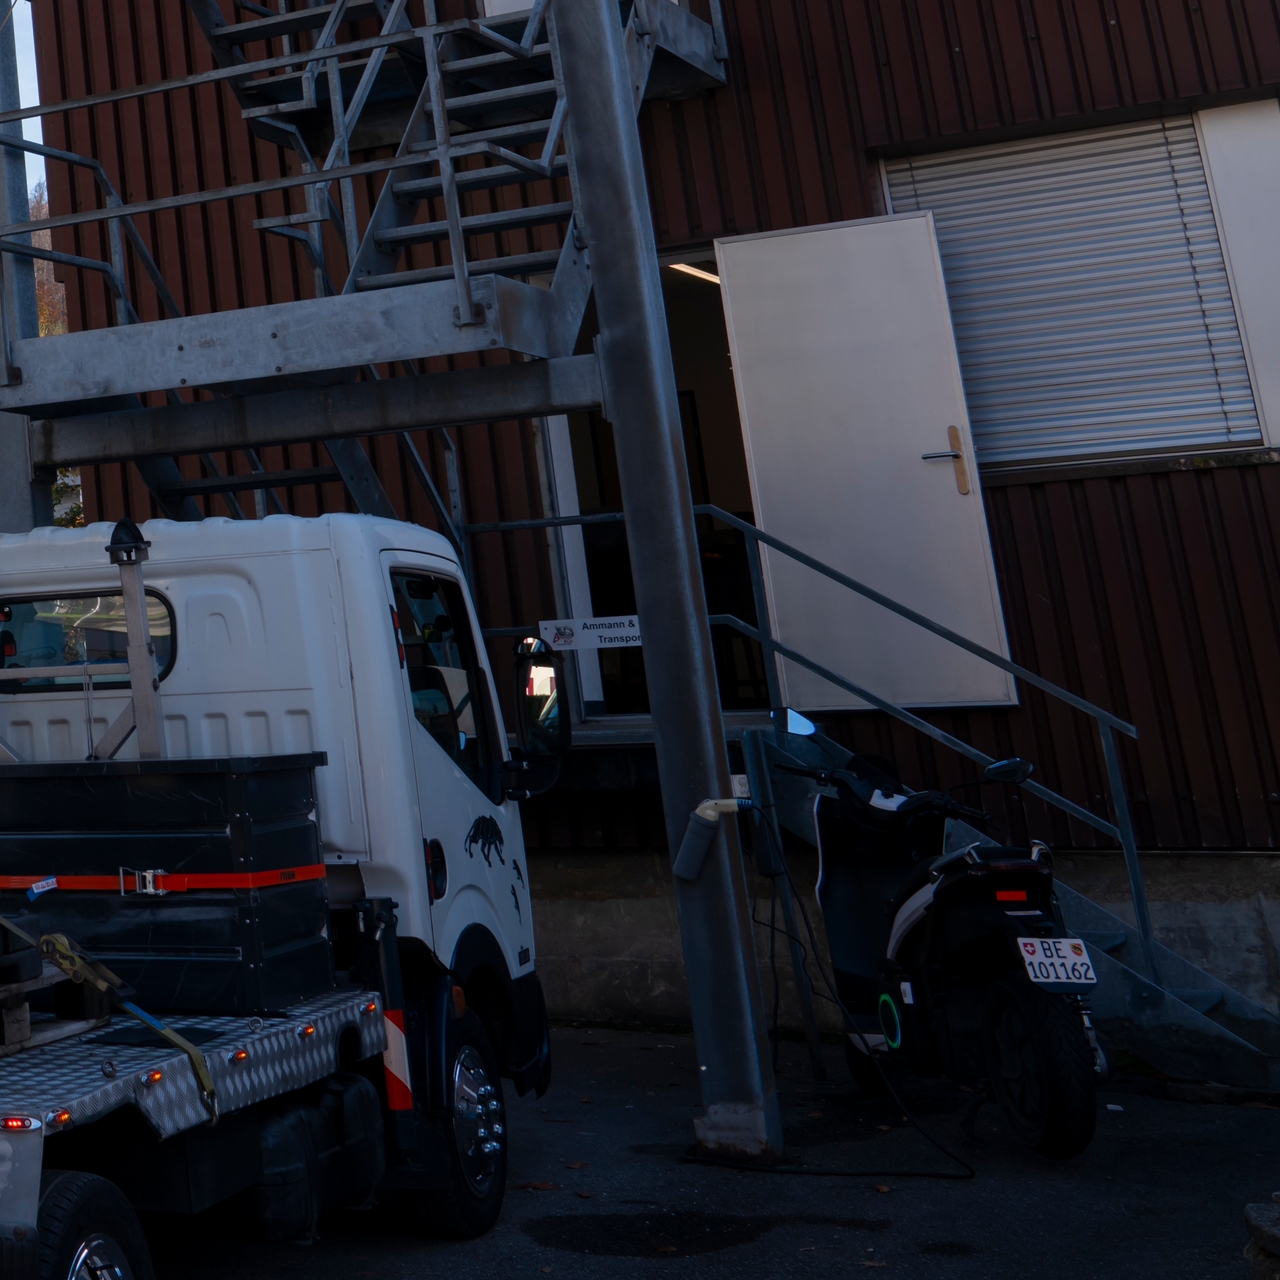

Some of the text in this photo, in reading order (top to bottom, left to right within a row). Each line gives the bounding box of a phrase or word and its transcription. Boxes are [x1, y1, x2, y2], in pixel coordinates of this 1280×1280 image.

[582, 621, 625, 631] Ammann
[598, 634, 641, 644] Transpor
[1040, 940, 1067, 959] BE
[1027, 961, 1095, 981] 101162
